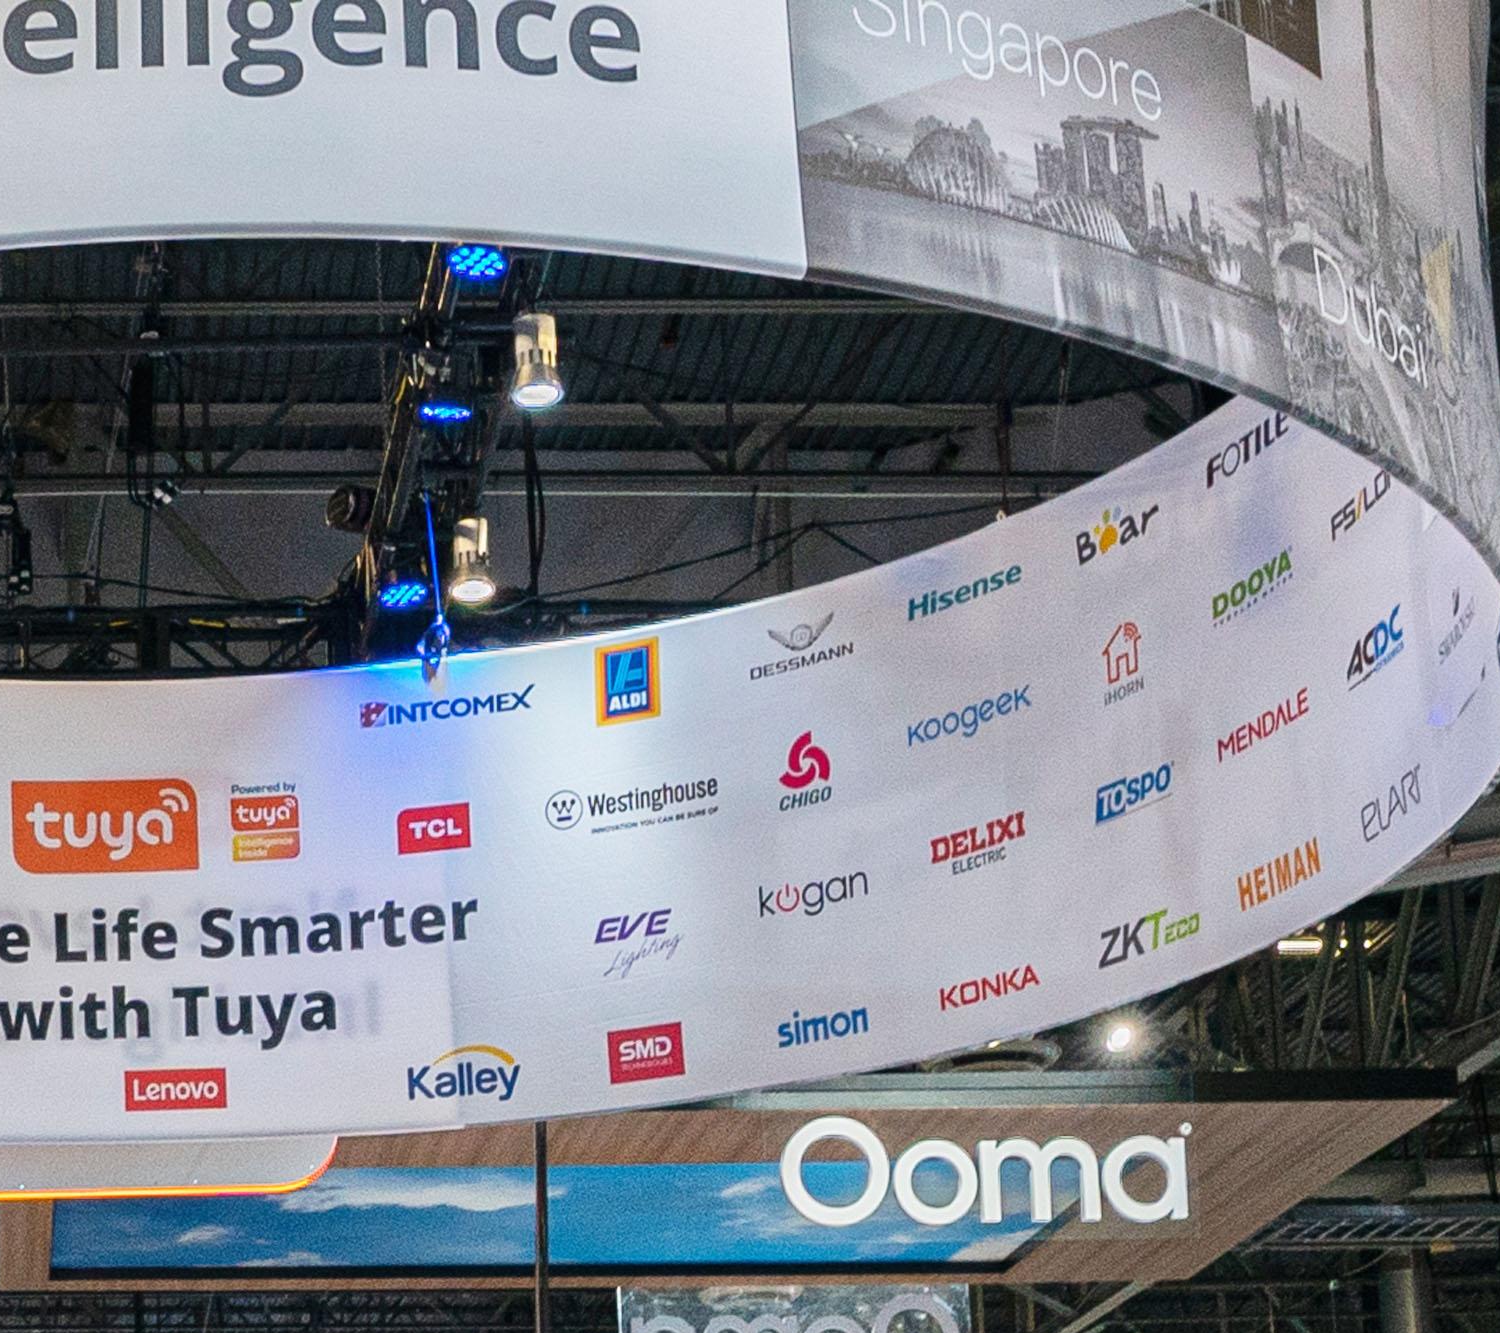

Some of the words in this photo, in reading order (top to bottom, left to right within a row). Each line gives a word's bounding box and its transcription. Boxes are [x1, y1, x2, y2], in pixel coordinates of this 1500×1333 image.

[853, 0, 1162, 121] Singapore
[1315, 245, 1427, 389] Dubai
[1205, 413, 1290, 488] FOTILE
[907, 564, 1022, 621] Hisense
[1212, 549, 1292, 620] DOOYA
[749, 642, 854, 681] DESSMANN
[1347, 604, 1404, 682] ACDC
[387, 685, 534, 726] INTCOMEX
[609, 690, 648, 711] ALDI
[1217, 688, 1310, 763] MENDALE
[231, 783, 280, 794] Powered
[283, 782, 296, 793] by
[587, 778, 718, 816] Westinghouse
[779, 786, 832, 813] CHIGO
[1097, 763, 1173, 824] TOSPO
[25, 800, 172, 861] tuya
[236, 805, 290, 826] tuya
[408, 818, 462, 841] TCL
[931, 811, 1025, 864] DELIXI
[952, 846, 1007, 875] ELECTRIC
[1237, 838, 1321, 912] HEIMAN
[758, 870, 869, 918] kogan
[55, 906, 178, 963] Life
[200, 898, 479, 961] Smarter
[594, 908, 672, 944] EVE
[939, 965, 1040, 1011] KONKA
[173, 984, 338, 1049] Tuya
[777, 1007, 869, 1049] simon
[619, 1036, 672, 1062] SMD
[132, 1077, 219, 1103] Lenovo
[407, 1062, 521, 1101] Kalley
[781, 1116, 1190, 1225] Ooma
